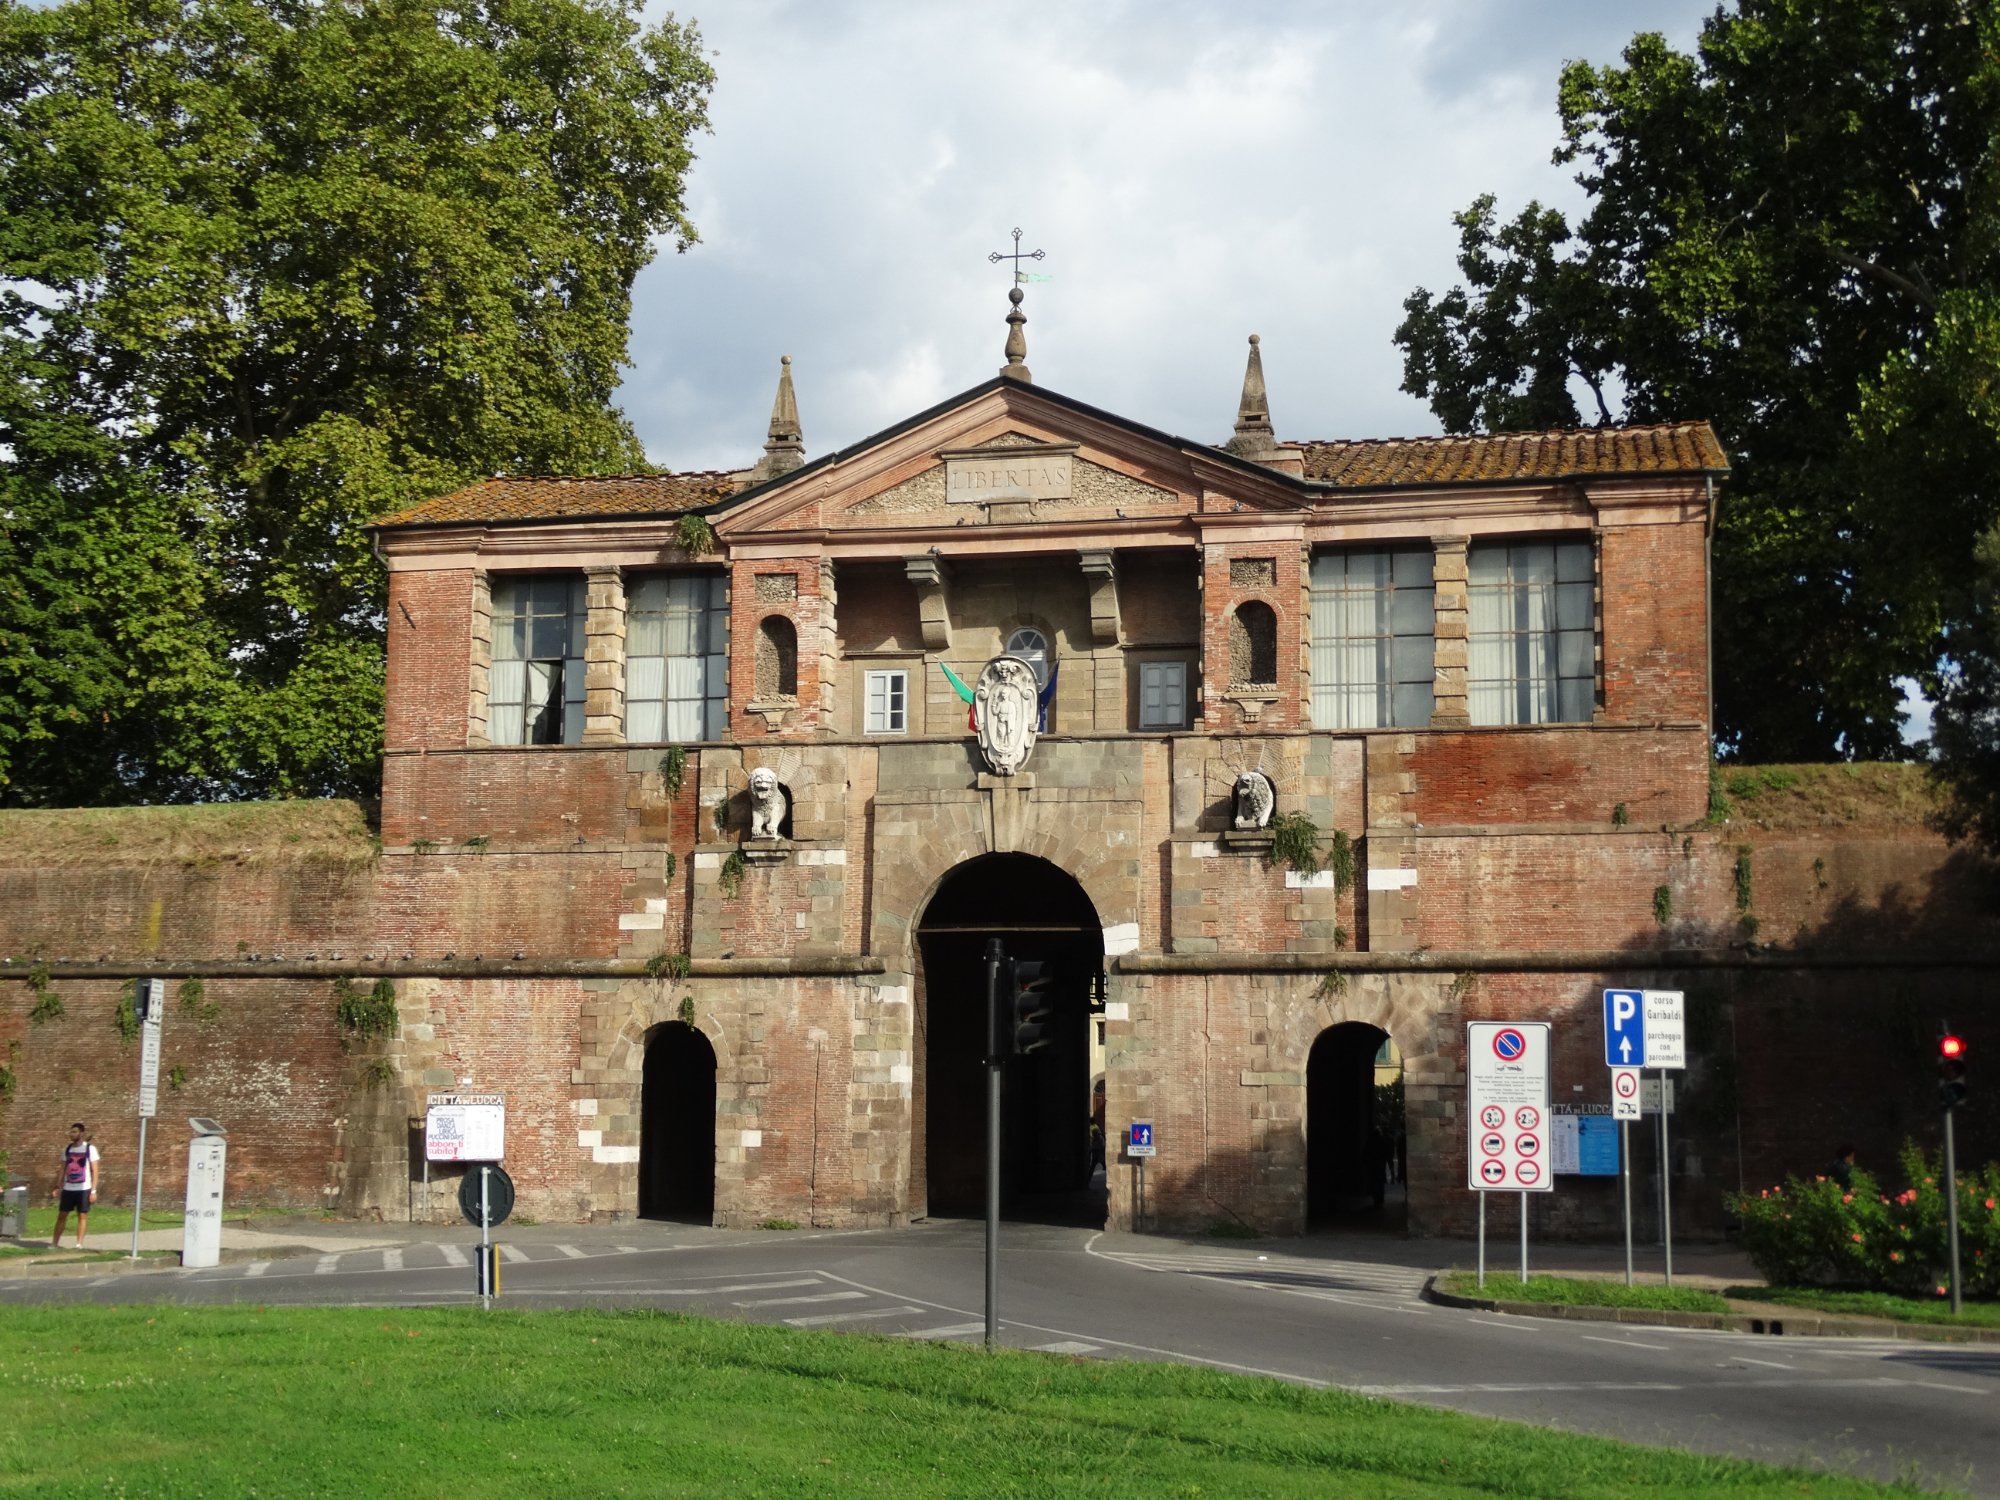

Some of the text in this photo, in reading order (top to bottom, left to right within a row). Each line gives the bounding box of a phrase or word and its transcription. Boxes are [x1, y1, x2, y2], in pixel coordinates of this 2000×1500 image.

[952, 467, 1066, 489] LIBERTAS
[1654, 997, 1674, 1005] corso
[1613, 994, 1635, 1031] P
[1647, 1009, 1681, 1020] Garibaldi
[1648, 1032, 1682, 1042] parcheggio
[1659, 1043, 1671, 1051] con
[1648, 1053, 1682, 1062] parcometri
